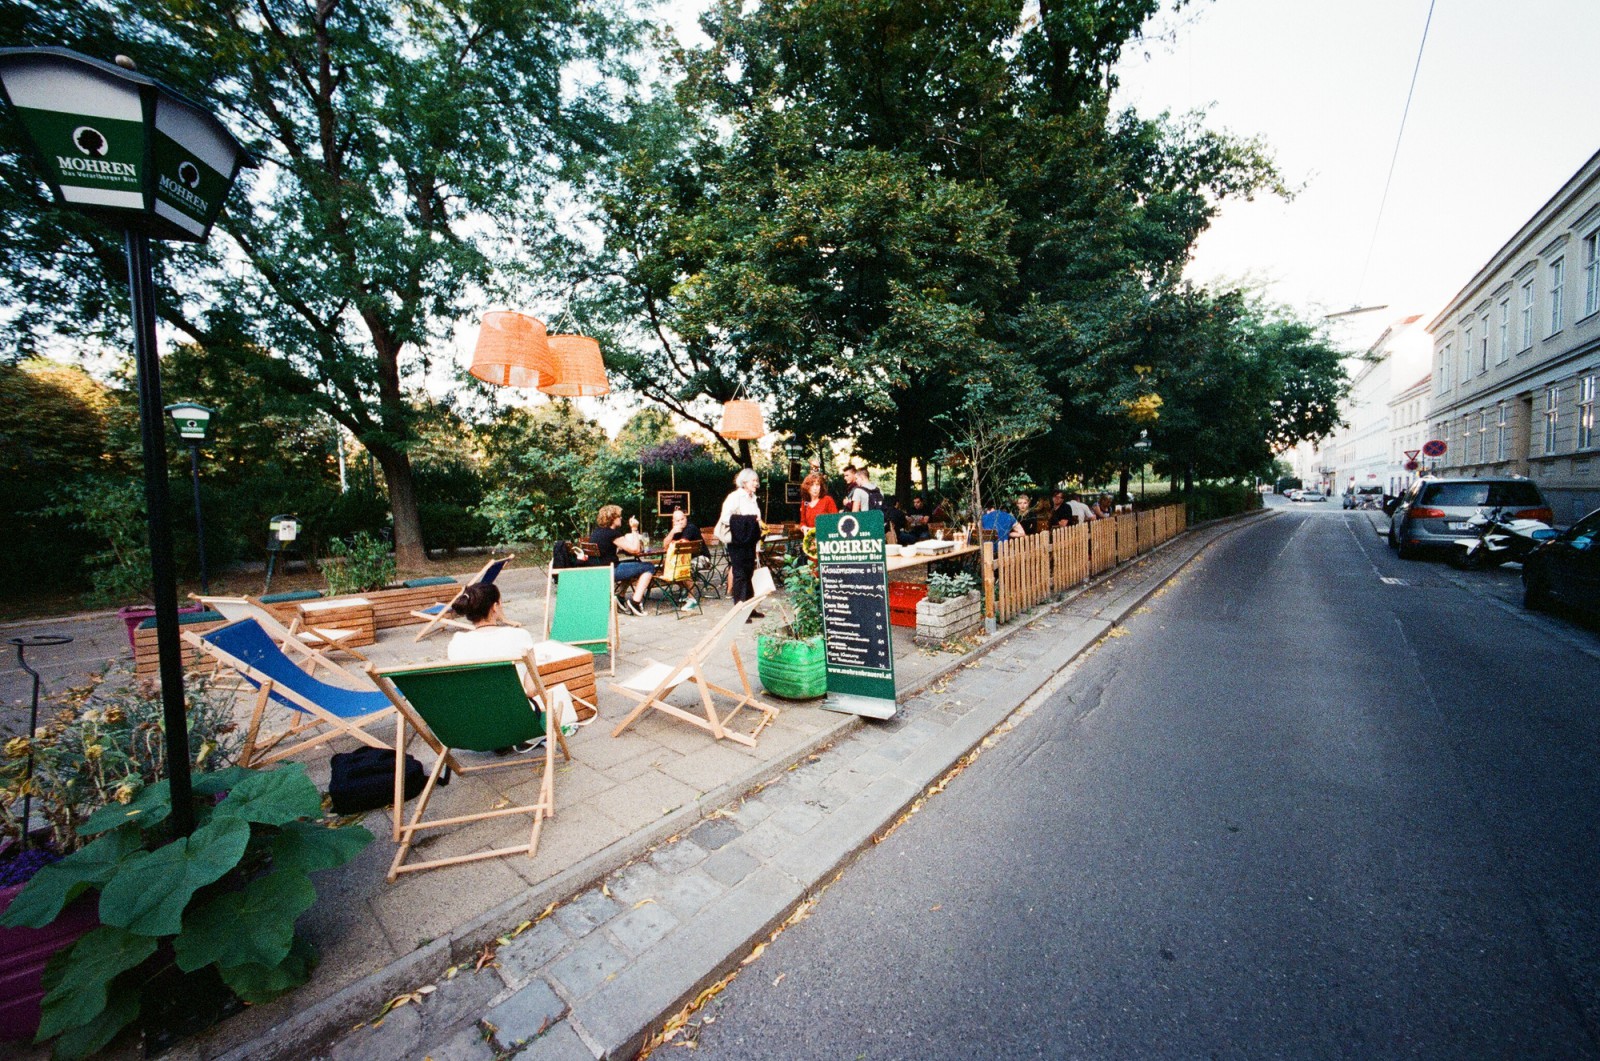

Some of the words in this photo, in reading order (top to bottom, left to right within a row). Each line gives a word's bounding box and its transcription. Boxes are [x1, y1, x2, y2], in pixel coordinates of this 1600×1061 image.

[56, 155, 136, 176] MOHREN
[62, 169, 75, 177] Das
[159, 173, 208, 211] MOHREN
[818, 538, 883, 554] MOHREN
